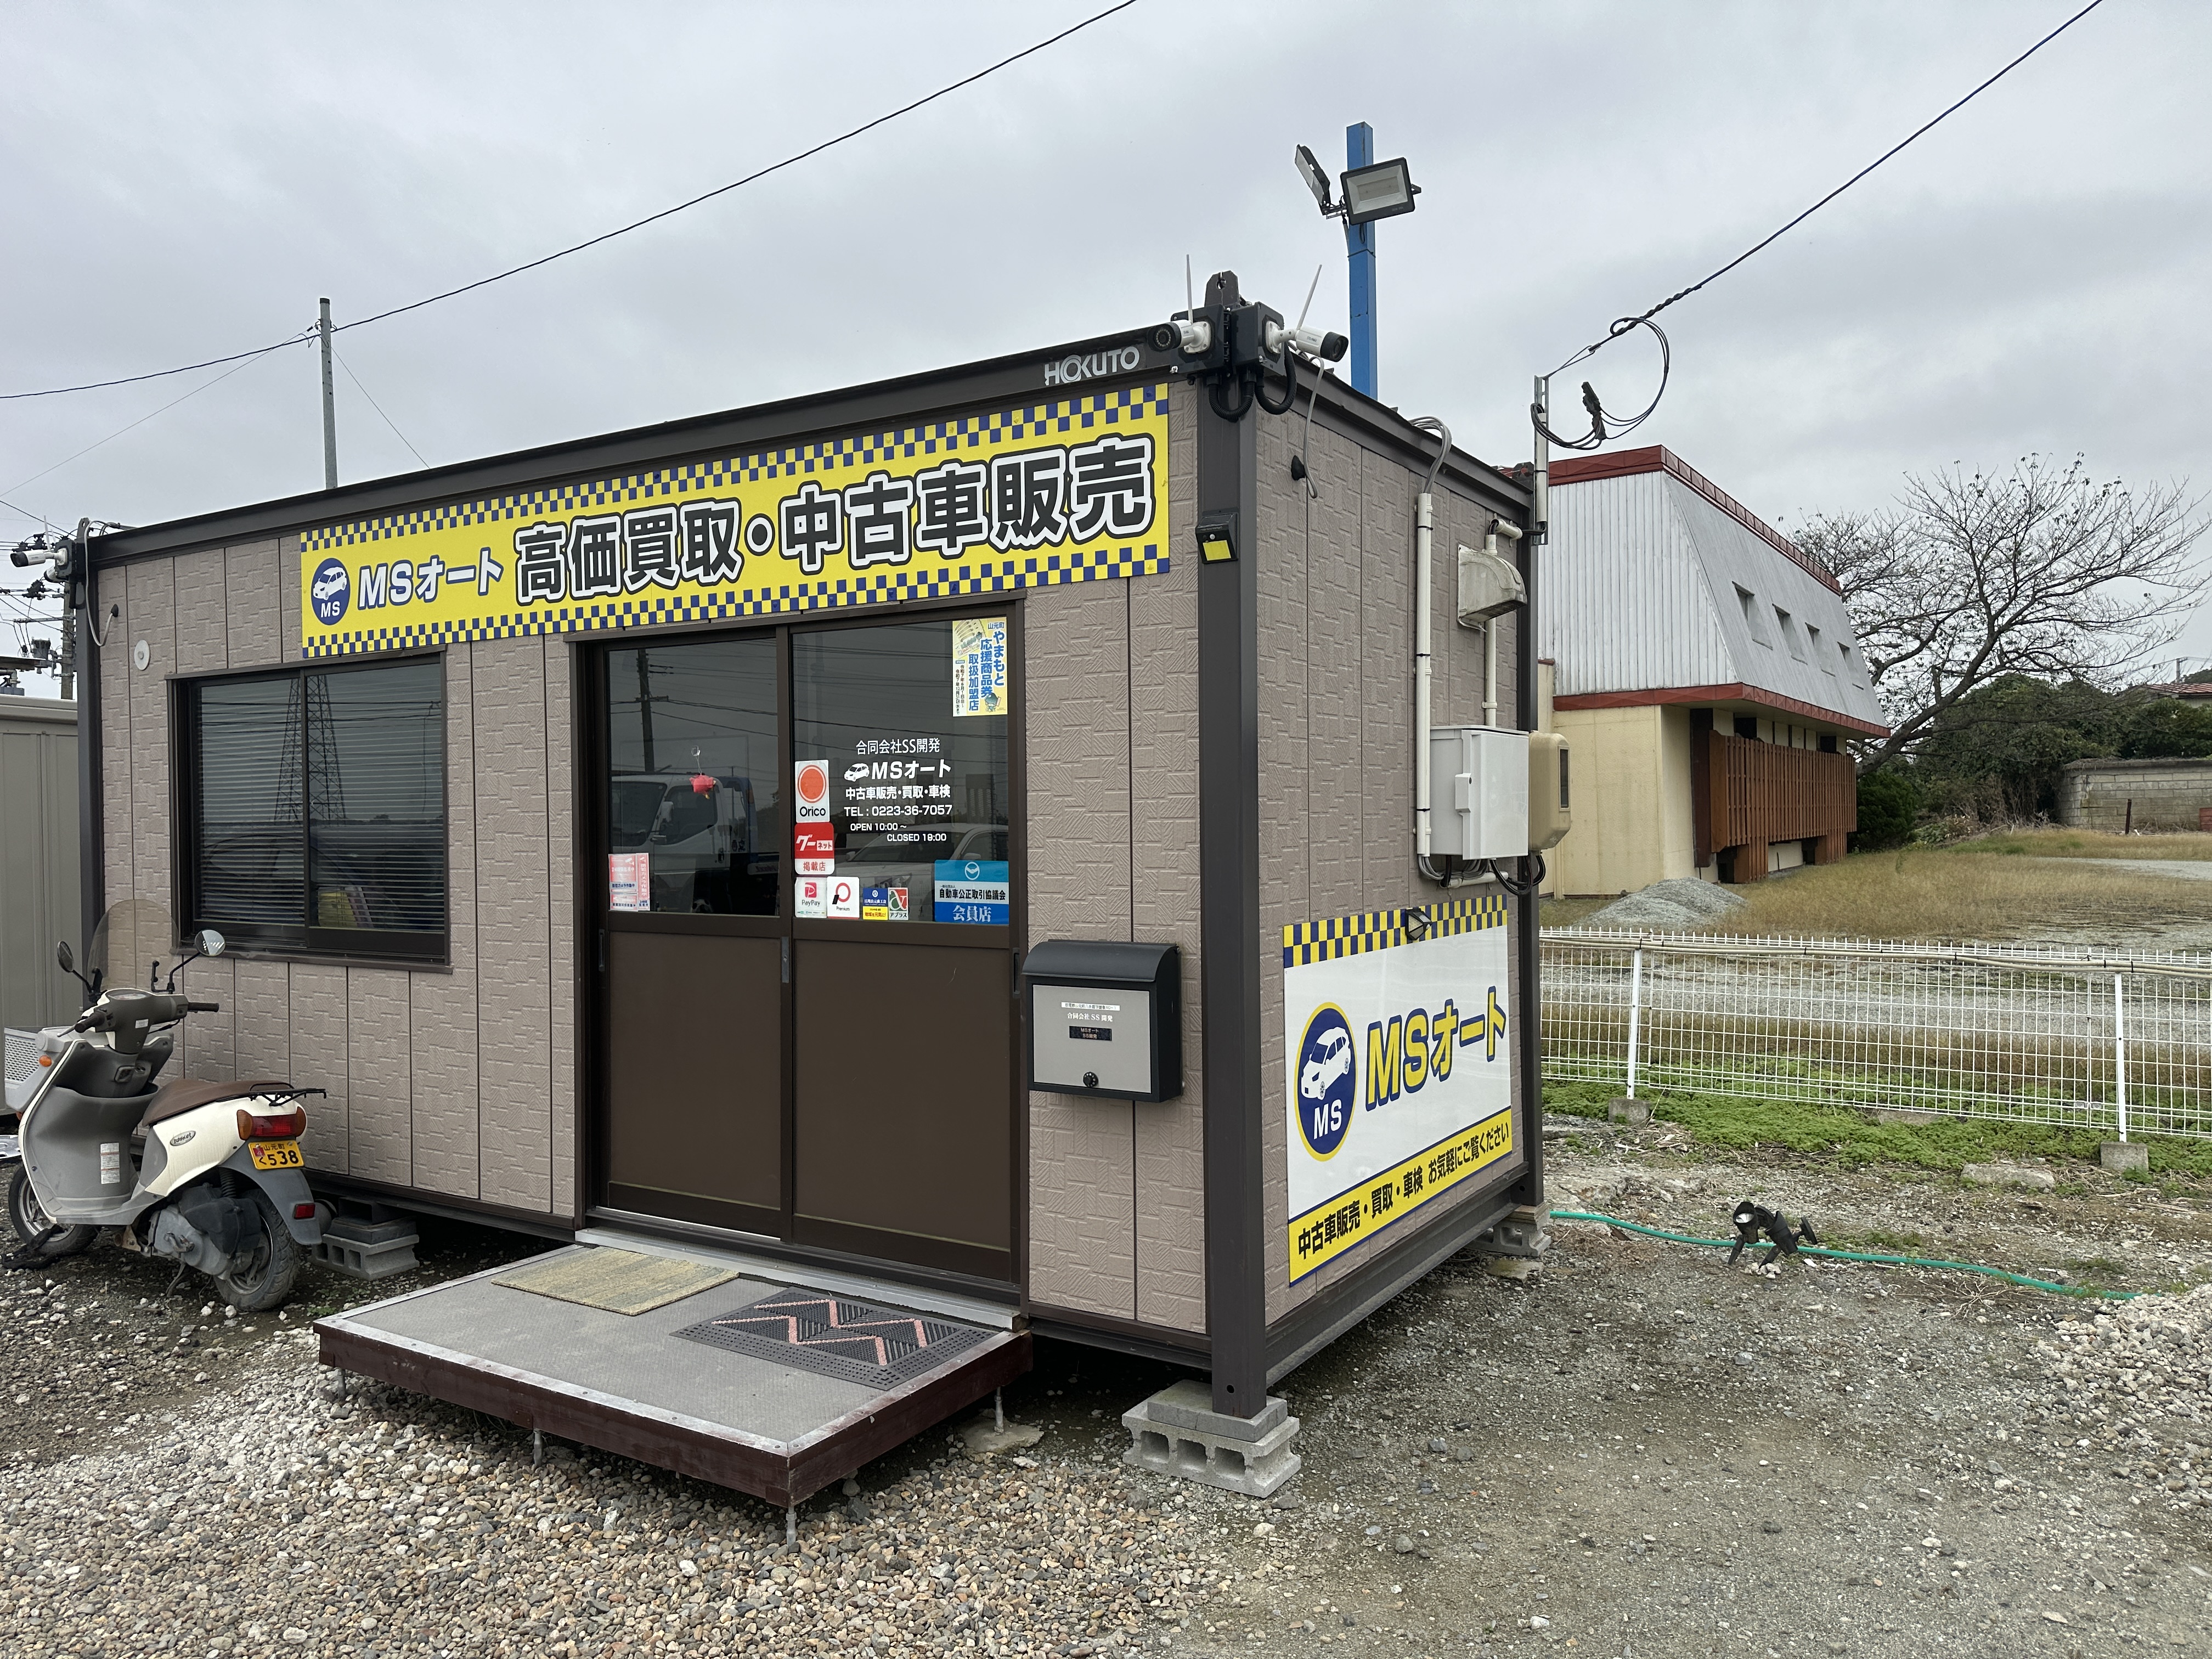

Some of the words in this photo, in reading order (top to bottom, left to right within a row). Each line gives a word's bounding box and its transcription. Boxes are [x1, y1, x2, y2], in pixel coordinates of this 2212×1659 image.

[1045, 346, 1140, 386] HOKUTO
[358, 547, 504, 610] MSオート
[514, 433, 1155, 606] 高価買取・中古車販売
[320, 601, 341, 618] MS
[988, 622, 1005, 630] 山元町
[993, 630, 1005, 686] やまもと
[980, 639, 993, 698] 応援商品券
[968, 653, 979, 712] 取扱加盟店
[856, 737, 940, 755] 合同会社SS開発
[871, 759, 952, 780] MSオート
[845, 784, 951, 800] 中古車販売・買取・車検
[799, 806, 826, 817] Orico
[872, 804, 953, 816] 0223-36-7057
[850, 823, 872, 831] OPEN
[887, 833, 920, 842] CLOSED
[803, 861, 826, 872] 掲載店
[939, 888, 1006, 900] 自動車公正取引協議会
[952, 905, 992, 922] 会員店
[1365, 986, 1506, 1111] MSオート
[1313, 1098, 1342, 1141] MS
[1297, 1165, 1424, 1260] 中古車販売・買取・車検
[1427, 1121, 1509, 1184] お気軽にご覧ください
